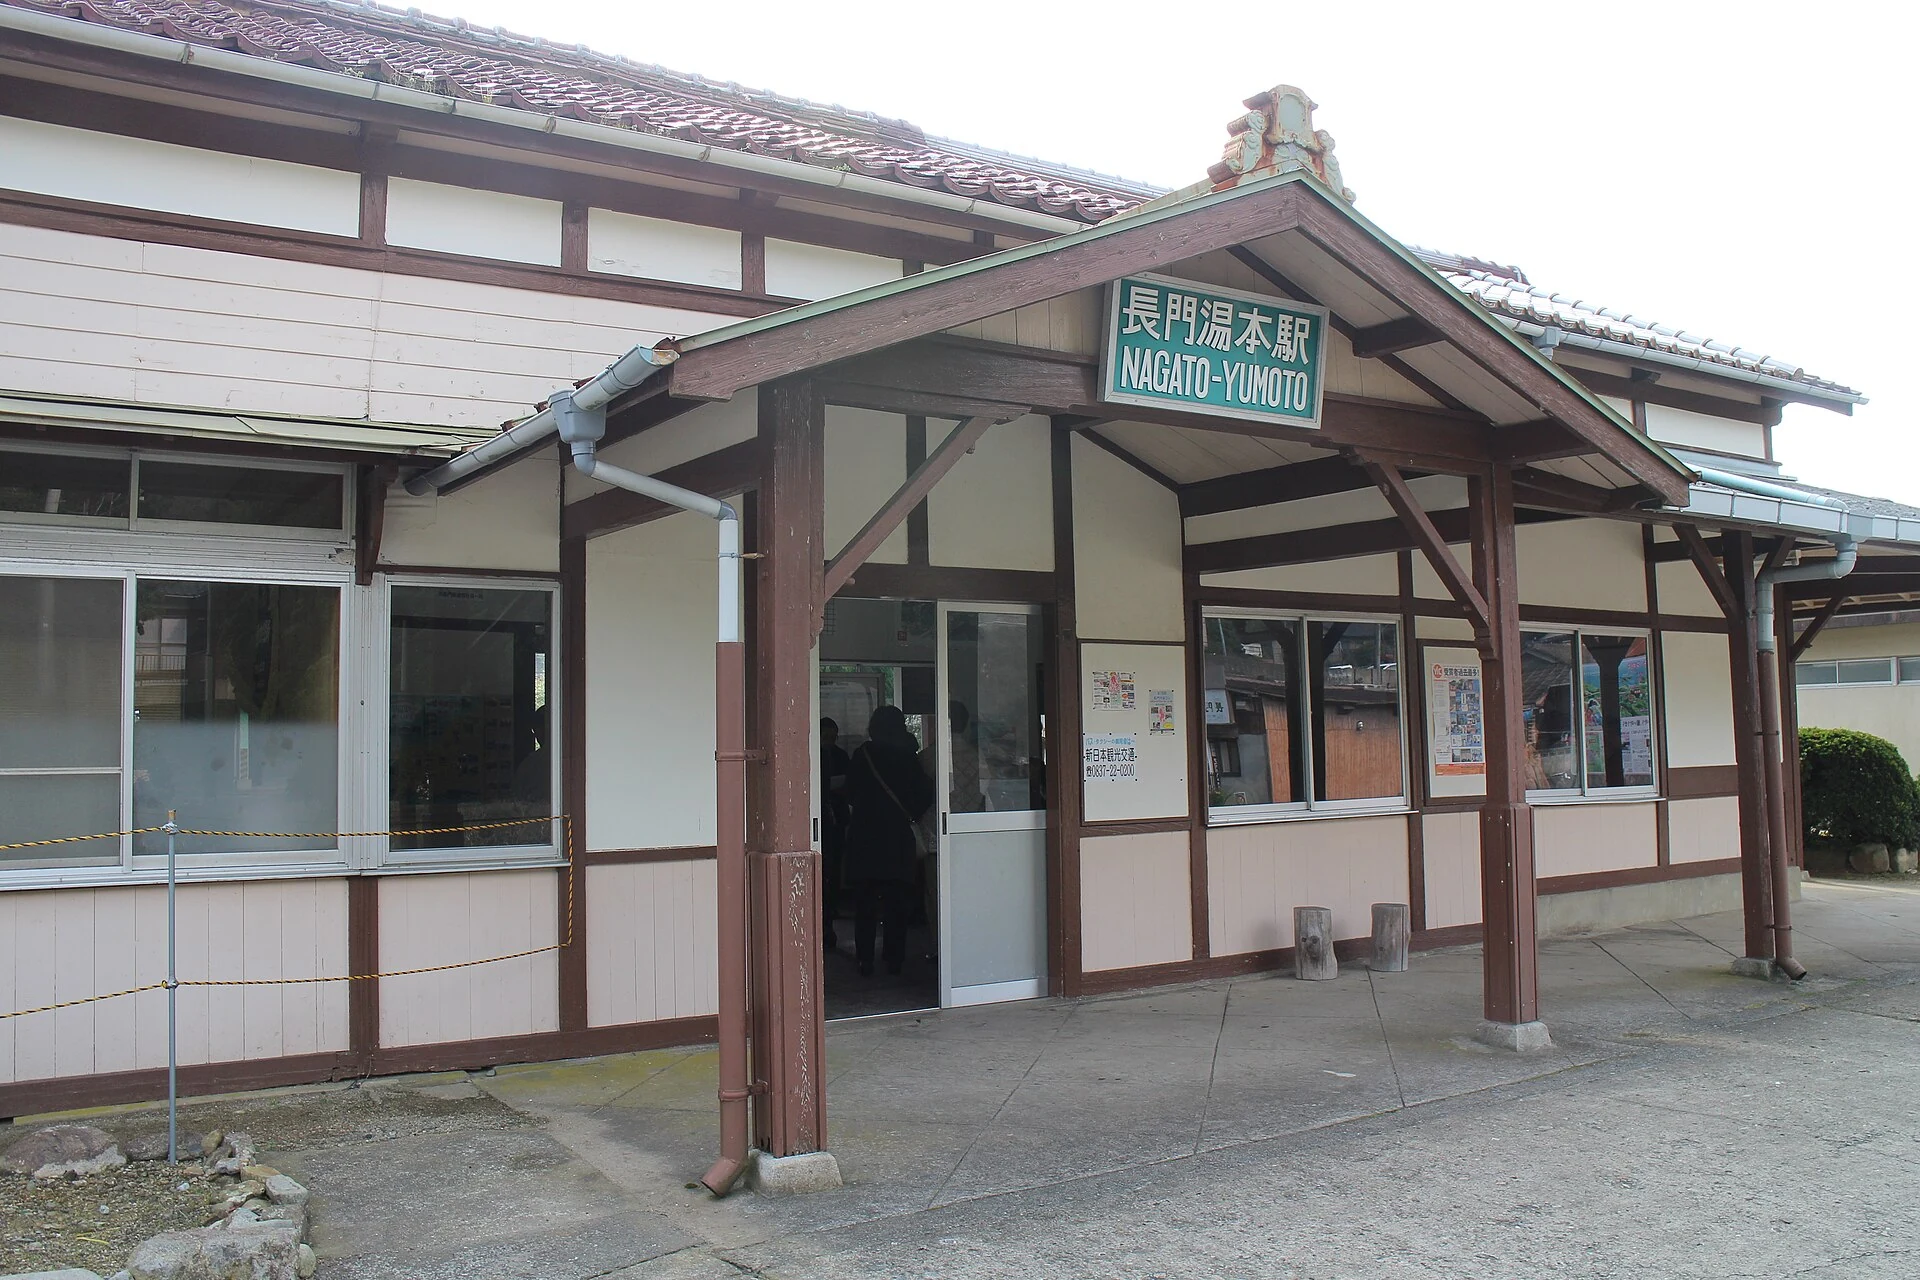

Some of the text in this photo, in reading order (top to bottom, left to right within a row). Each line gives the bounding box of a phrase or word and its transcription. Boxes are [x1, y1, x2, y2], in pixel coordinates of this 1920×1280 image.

[1122, 286, 1310, 365] 長門湯本駅
[1121, 346, 1308, 411] NAGATO-YUMOTO
[1086, 748, 1135, 762] 新日本観光交通
